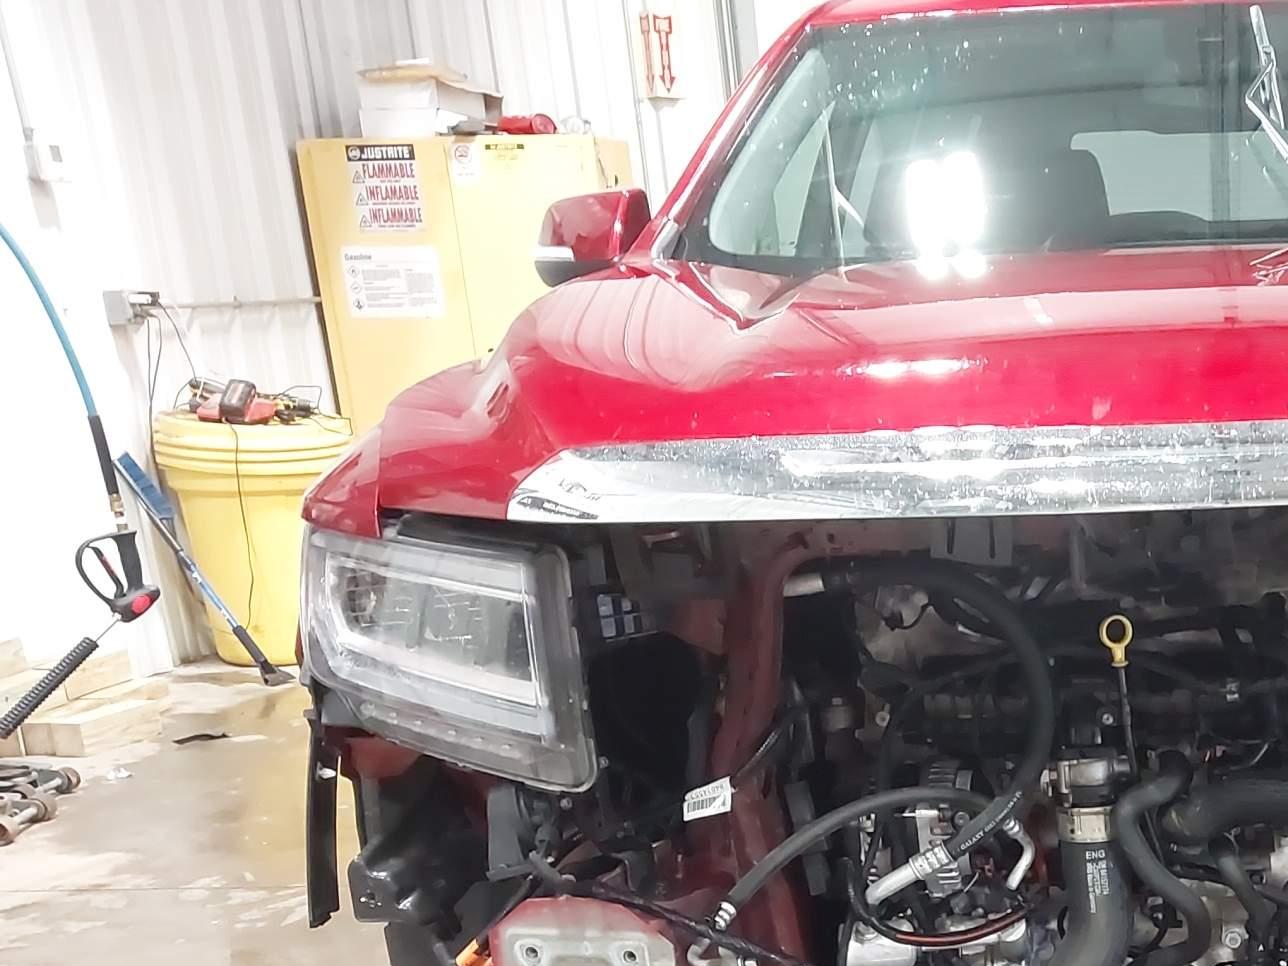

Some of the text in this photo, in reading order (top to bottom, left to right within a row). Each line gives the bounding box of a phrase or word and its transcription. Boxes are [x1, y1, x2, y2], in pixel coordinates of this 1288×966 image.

[362, 146, 410, 160] JUSTRITE
[361, 163, 416, 179] FLAMMABLE
[365, 185, 420, 201] INFLAMABLE
[369, 207, 423, 224] INFLAMMABLE
[960, 829, 985, 850] GALAXY
[1085, 850, 1106, 860] ENG
